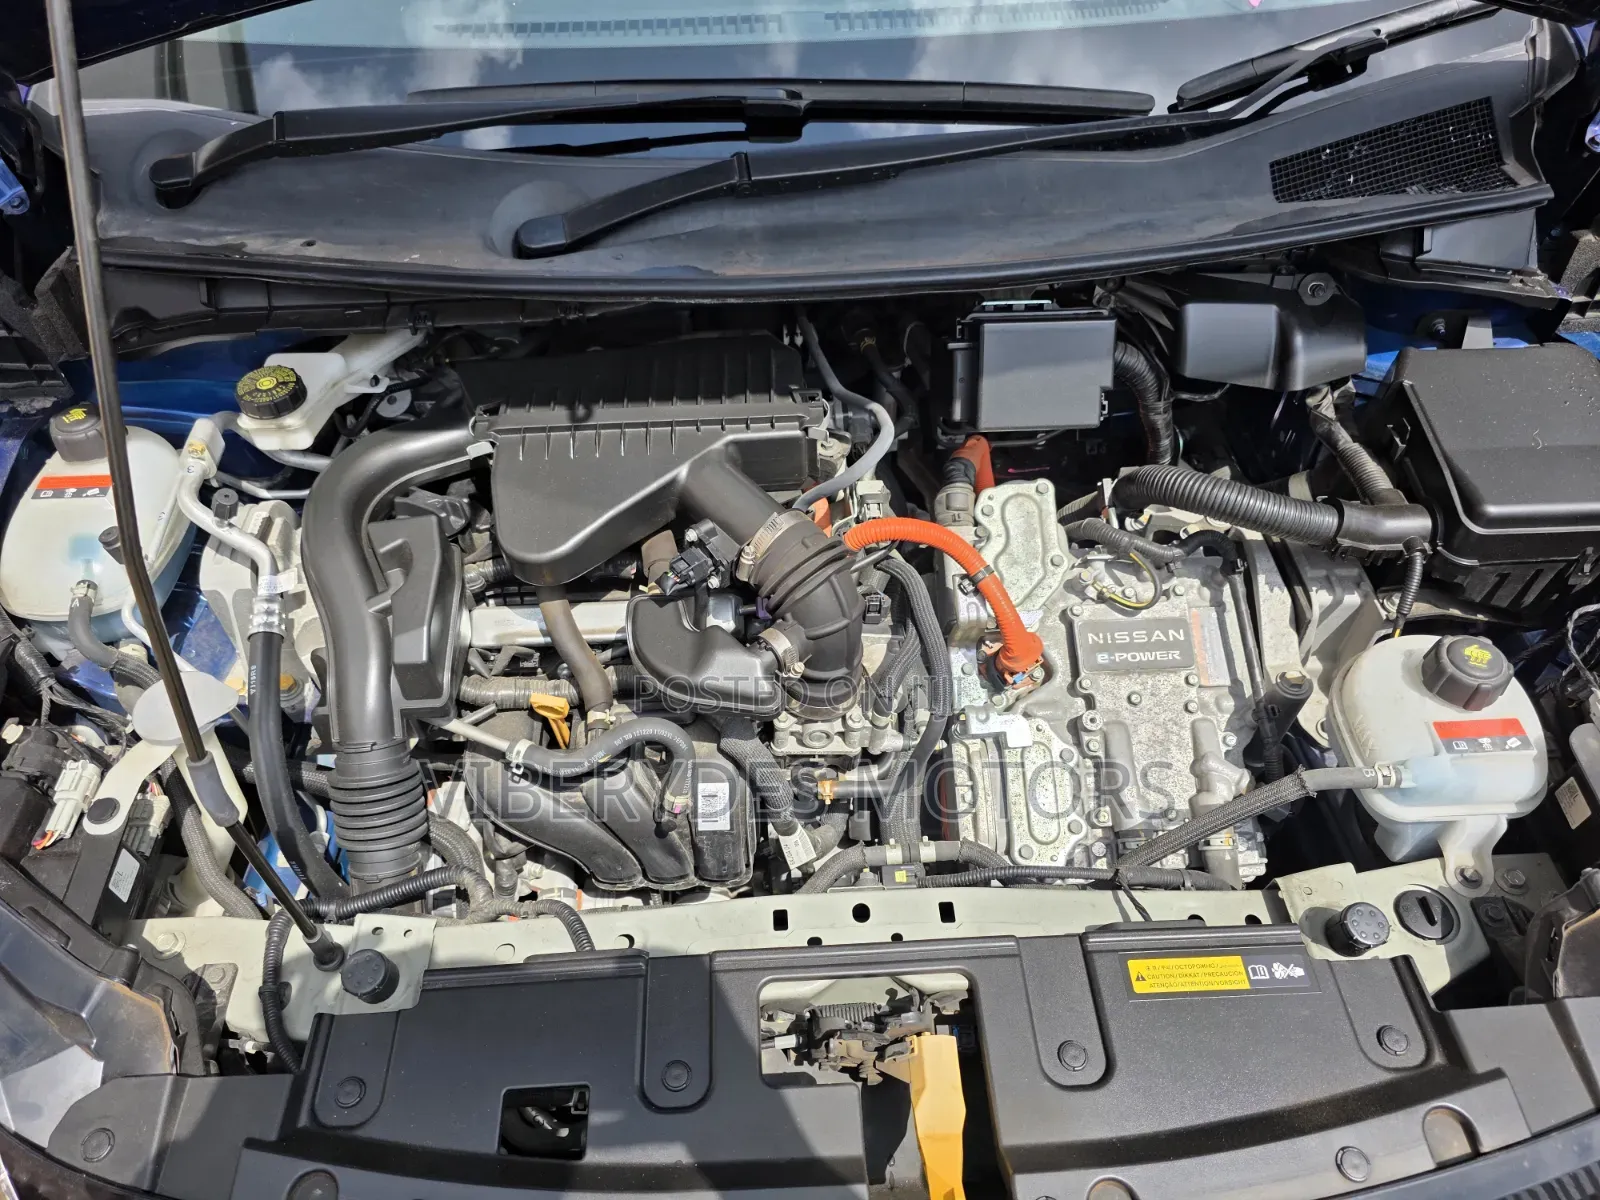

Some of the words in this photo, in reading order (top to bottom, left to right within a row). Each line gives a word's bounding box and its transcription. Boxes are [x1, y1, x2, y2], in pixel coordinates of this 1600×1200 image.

[1087, 628, 1185, 645] NISSAN
[1096, 650, 1182, 663] e-POWER
[1362, 768, 1376, 778] B
